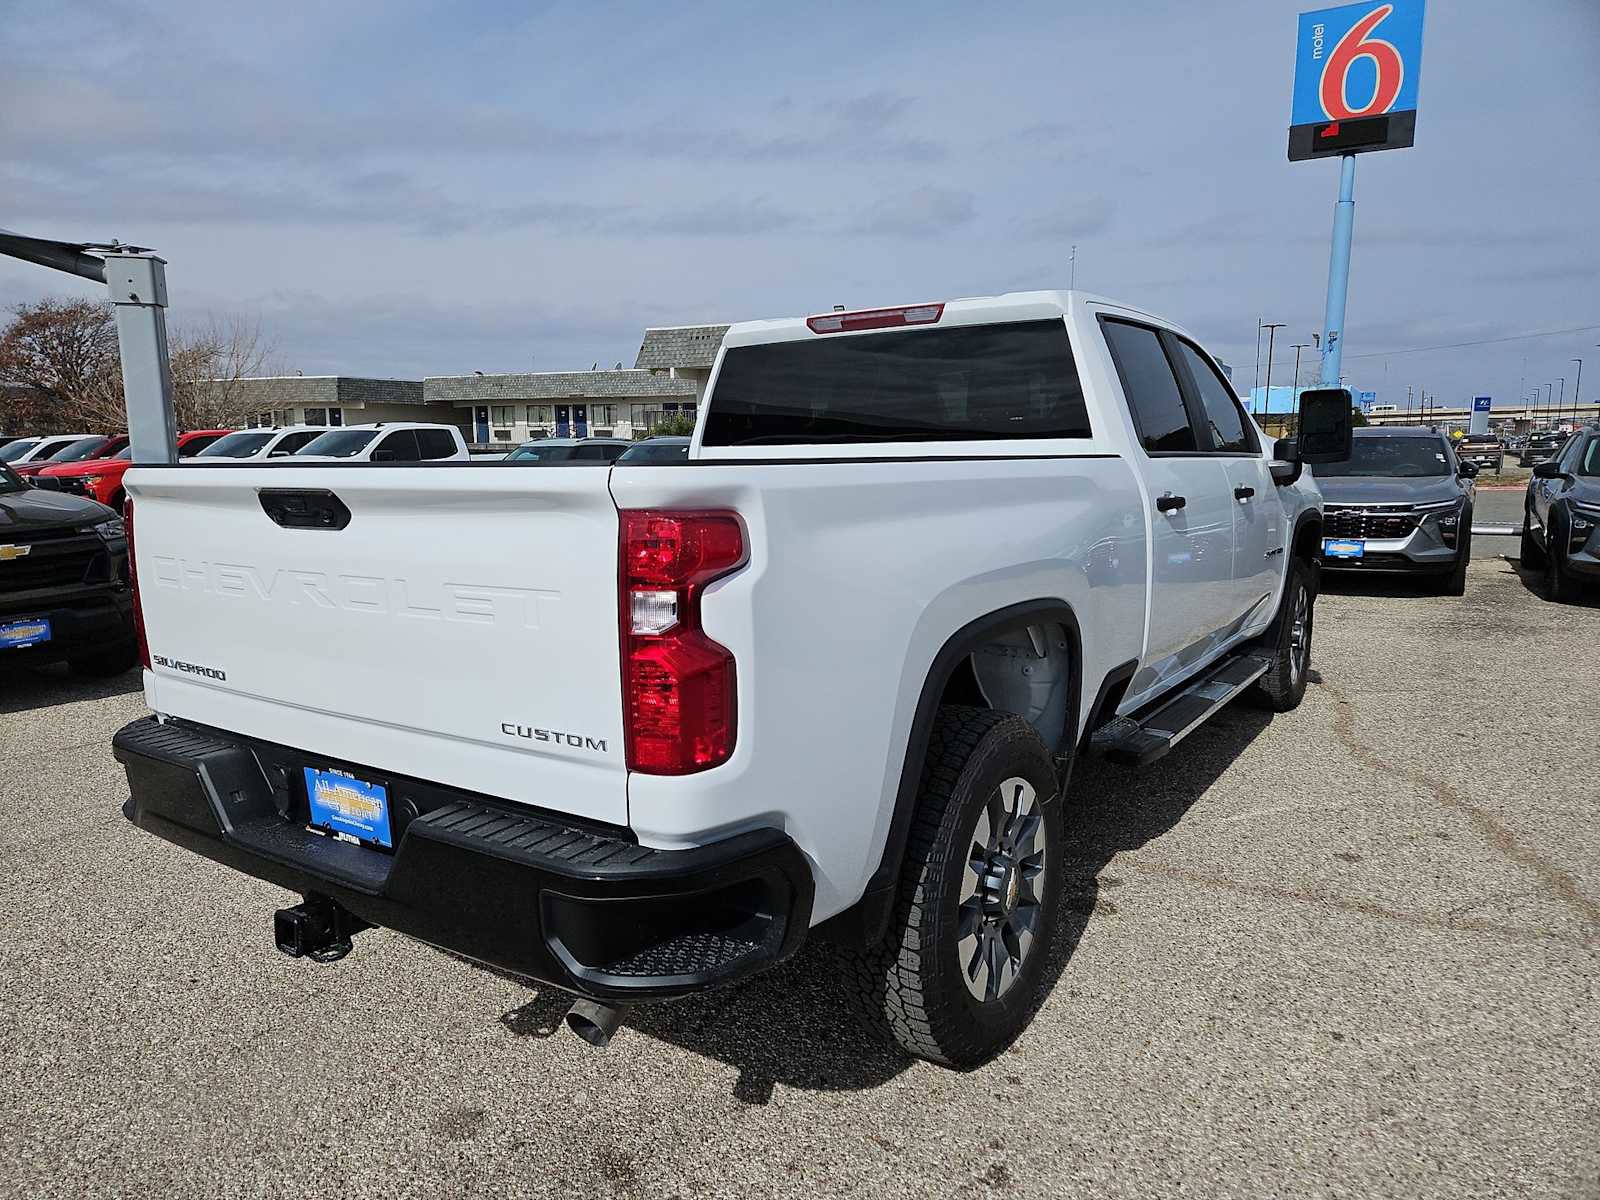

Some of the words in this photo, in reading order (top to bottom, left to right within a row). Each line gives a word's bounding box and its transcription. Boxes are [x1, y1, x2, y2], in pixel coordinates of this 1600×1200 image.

[1312, 23, 1325, 59] motel
[1319, 3, 1404, 121] 6
[152, 555, 561, 630] CHEVROLET
[153, 655, 226, 682] SILVERADO
[501, 722, 608, 752] CUSTOM
